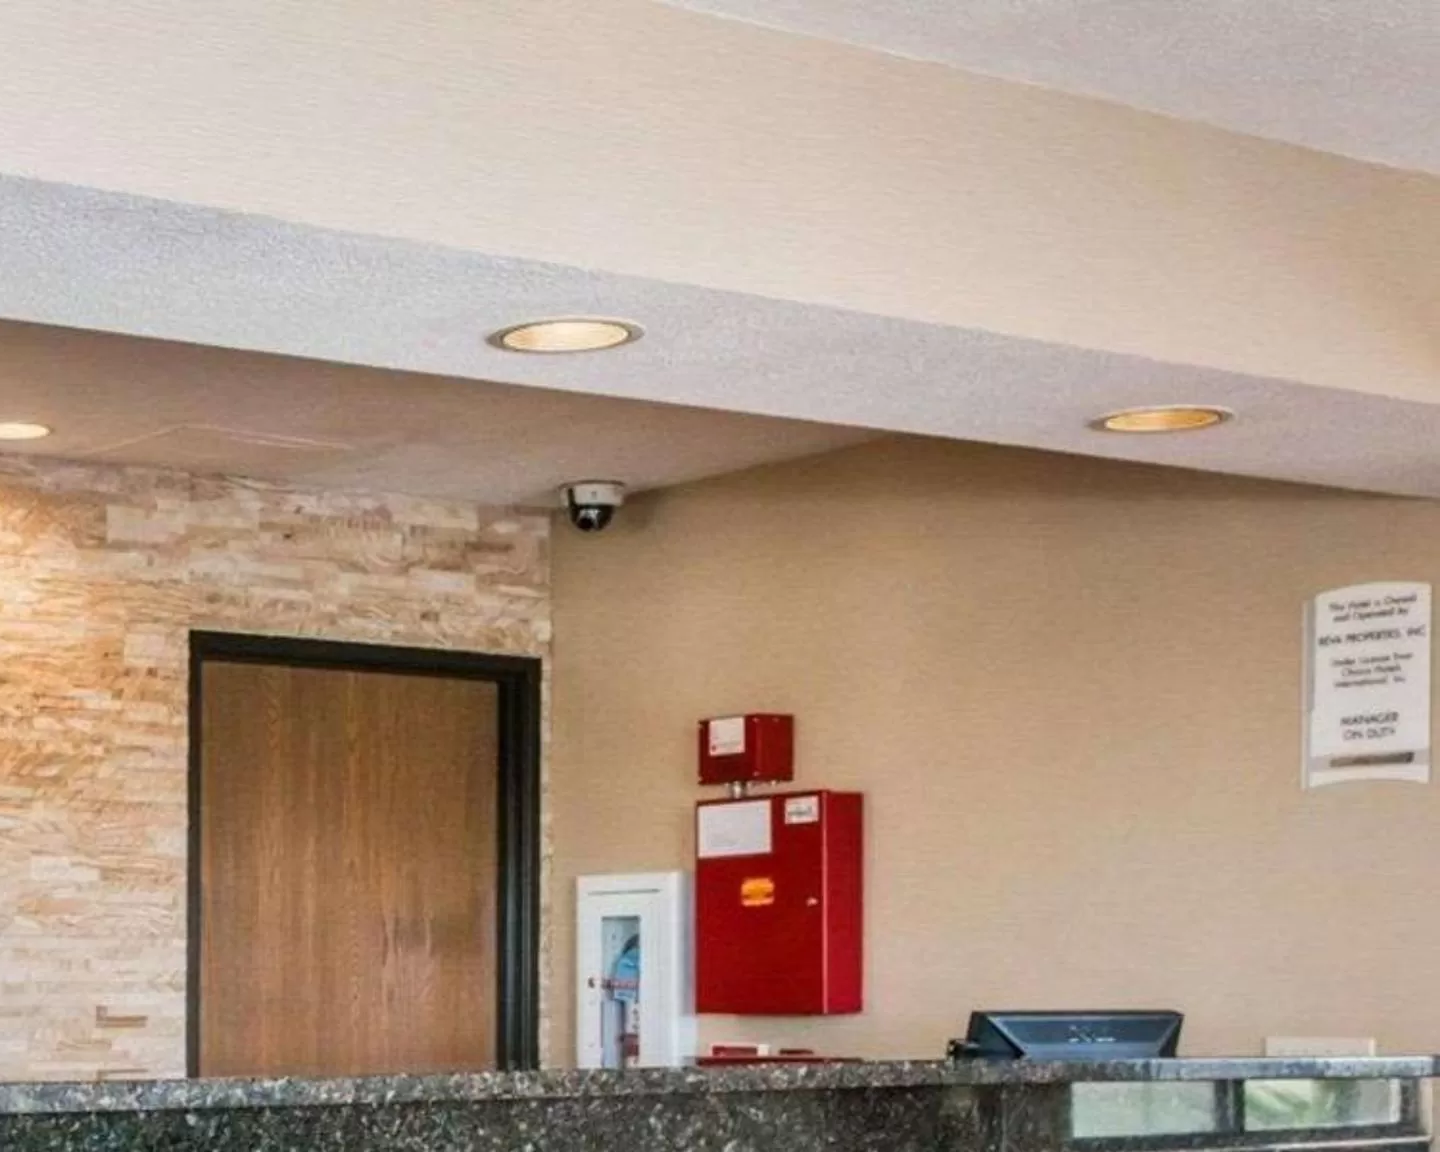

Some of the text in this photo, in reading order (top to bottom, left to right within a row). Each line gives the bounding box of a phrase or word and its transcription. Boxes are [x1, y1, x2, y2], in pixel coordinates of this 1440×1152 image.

[1340, 711, 1400, 728] MANAGER
[1343, 725, 1398, 742] ON DUTY
